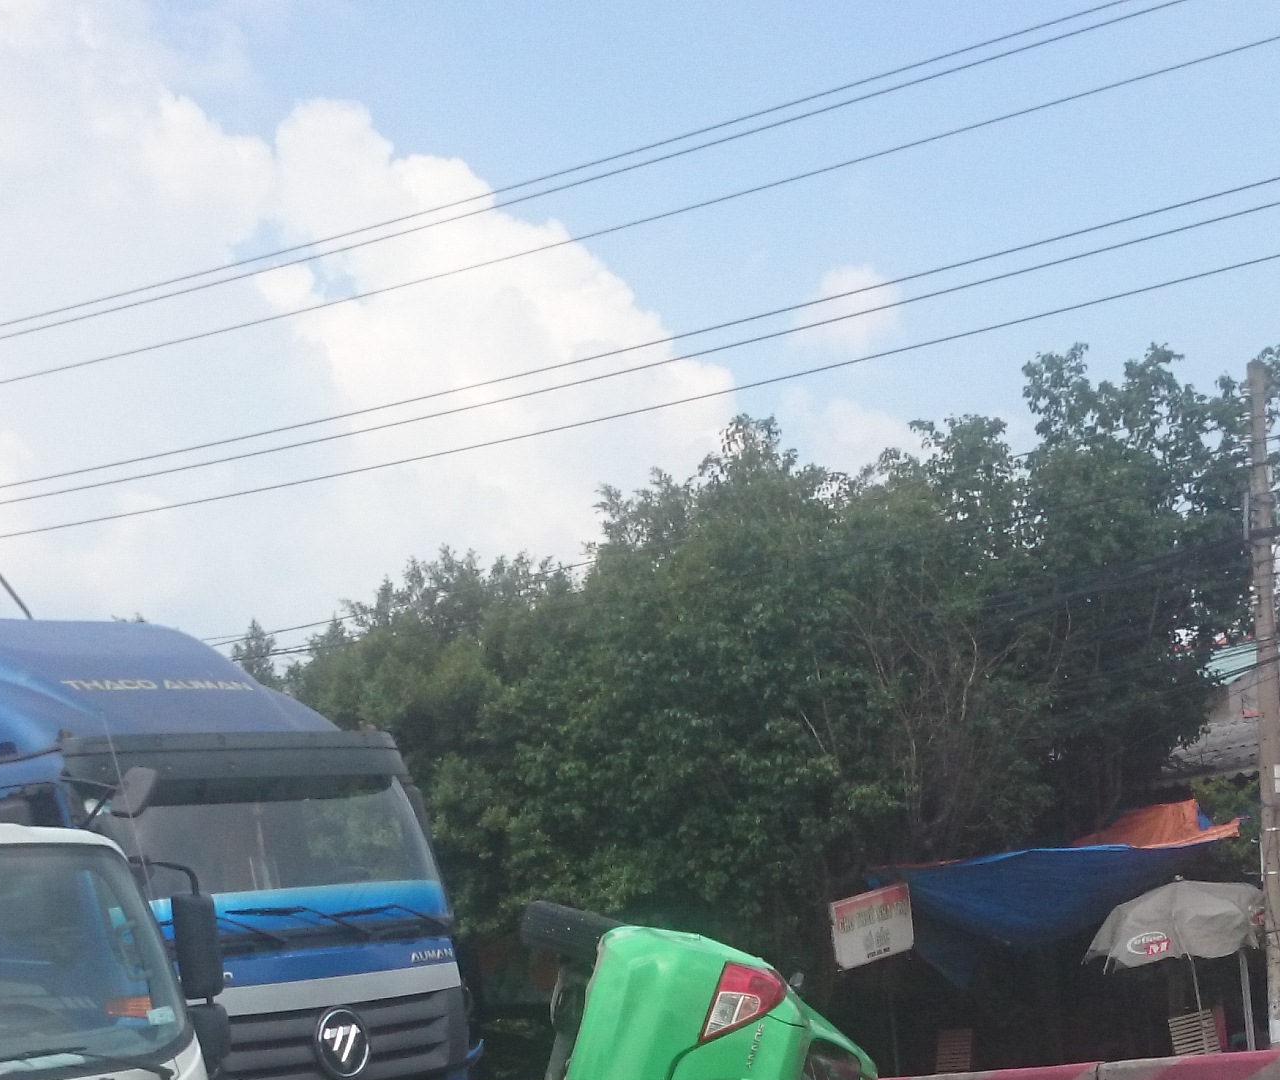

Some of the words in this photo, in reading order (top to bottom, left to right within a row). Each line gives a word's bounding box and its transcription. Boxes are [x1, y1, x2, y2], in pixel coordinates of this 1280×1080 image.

[60, 679, 158, 691] THACO
[163, 679, 254, 691] AUMAN
[411, 948, 453, 963] AUMAN
[745, 1022, 765, 1070] SUNNY
